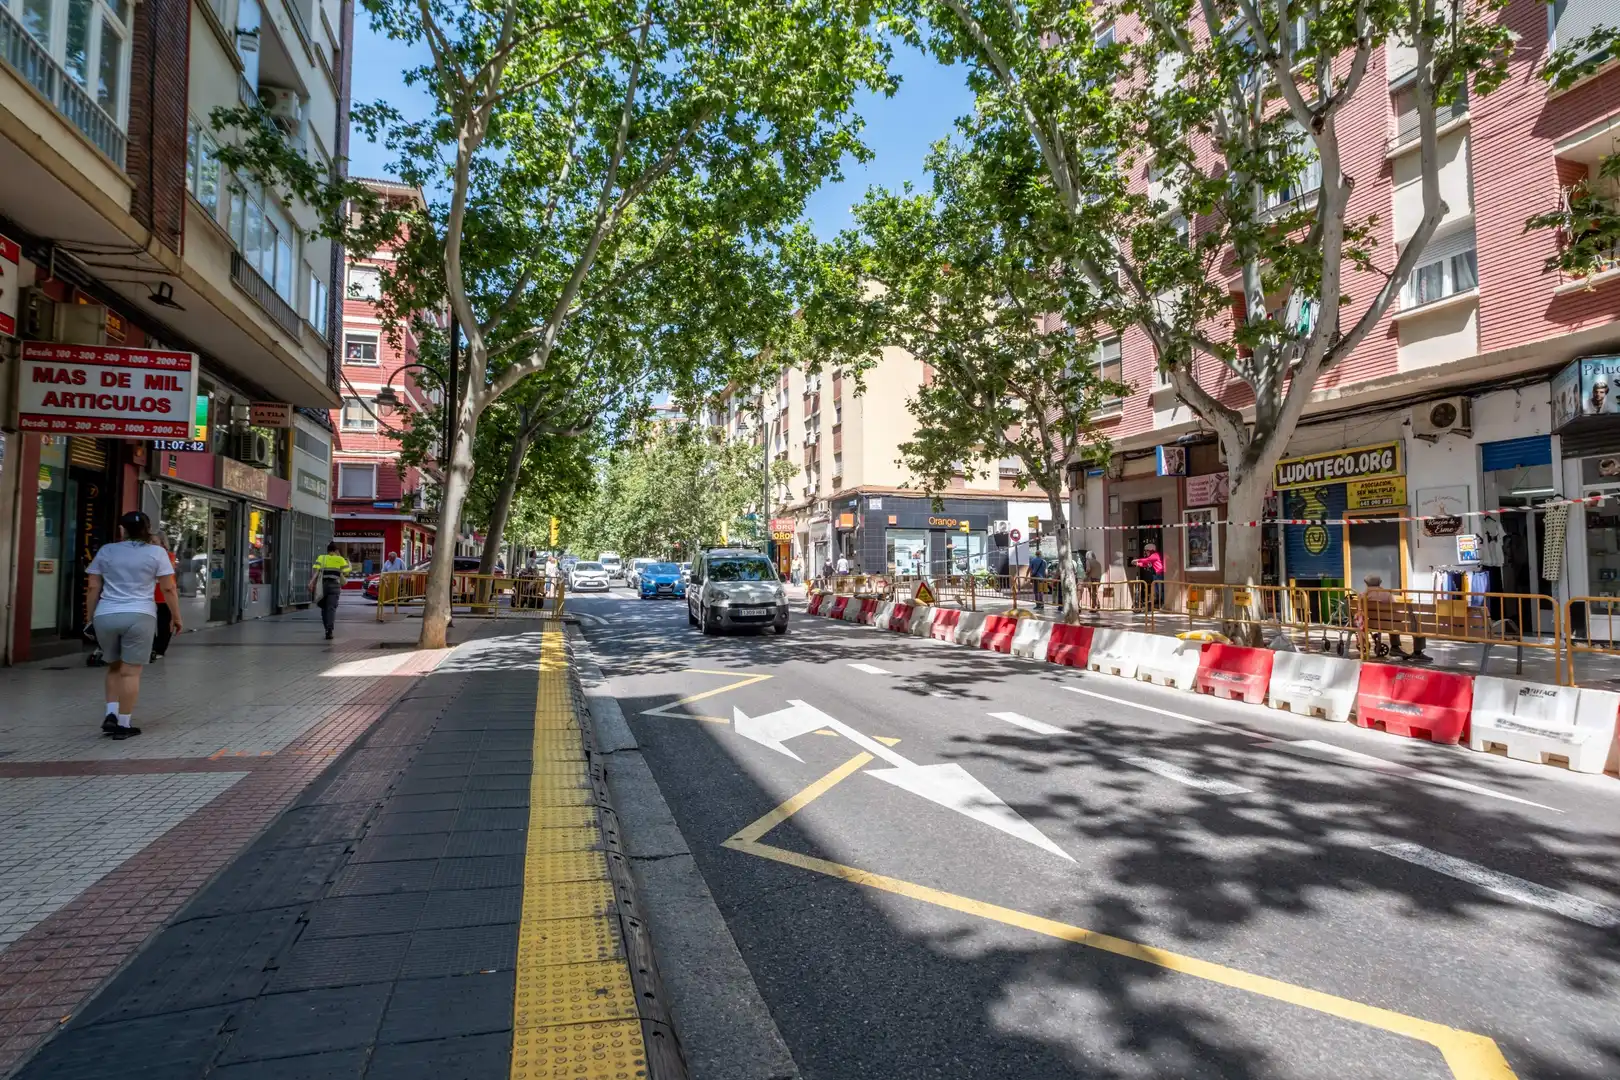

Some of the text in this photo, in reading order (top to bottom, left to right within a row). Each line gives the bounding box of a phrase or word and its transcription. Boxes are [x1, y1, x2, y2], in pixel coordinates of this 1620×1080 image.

[25, 347, 53, 357] Desde
[56, 349, 70, 358] 100
[79, 351, 96, 360] 300
[103, 353, 120, 362] 500
[128, 354, 149, 364] 1000
[156, 356, 177, 366] 2000
[32, 366, 183, 391] MAS DE MIL
[41, 390, 172, 413] ARTICULOS
[21, 418, 49, 428] Desde
[52, 420, 67, 429] 100
[74, 421, 92, 430] 300
[99, 423, 116, 431] 500
[124, 424, 145, 433] 1000
[152, 425, 173, 434] 2000
[154, 439, 204, 450] 11:07:42
[1279, 450, 1393, 483] LUDOTECO.ORG
[929, 516, 957, 527] Orange
[774, 531, 791, 540] ORO
